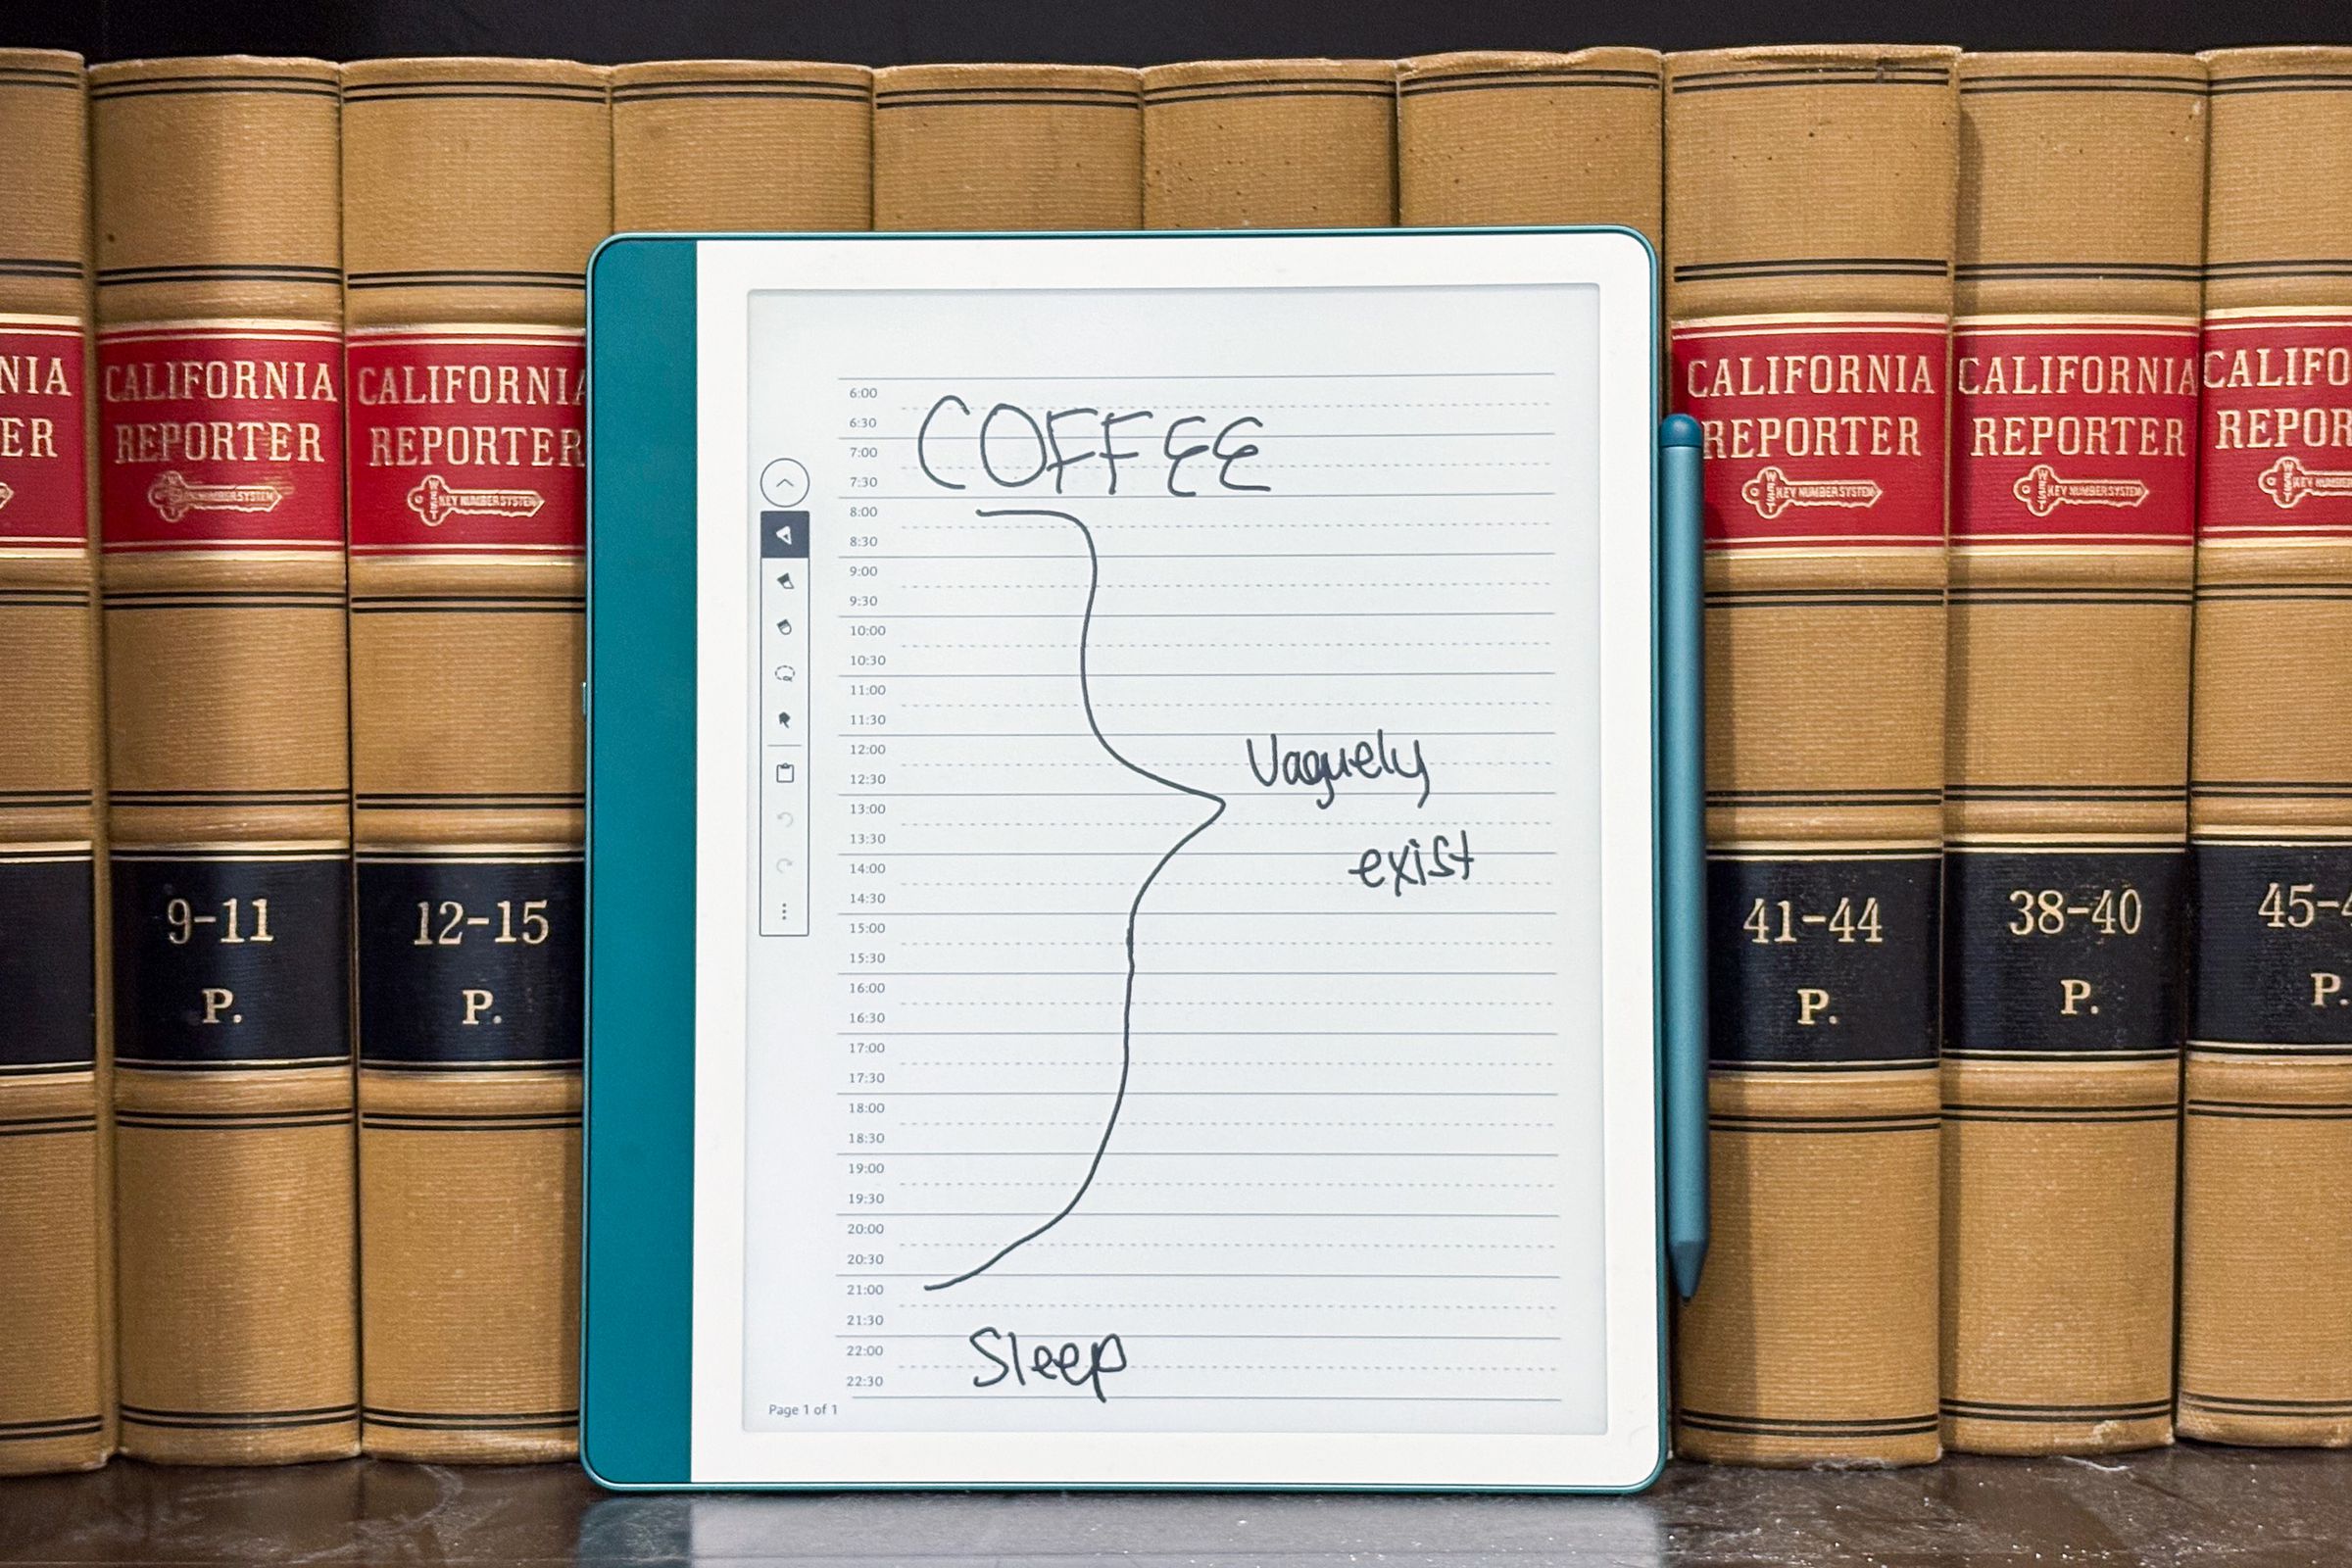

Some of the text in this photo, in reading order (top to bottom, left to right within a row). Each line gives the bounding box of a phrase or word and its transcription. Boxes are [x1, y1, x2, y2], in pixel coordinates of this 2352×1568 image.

[105, 361, 338, 403] CALIFORNIA
[1687, 355, 1936, 398] CALIFORNIA
[1958, 355, 2198, 396] CALIFORNIA
[849, 387, 878, 399] 6:00
[849, 416, 878, 429] 6:30
[115, 421, 325, 465] REPORTER
[1701, 416, 1921, 460] REPORTER
[1970, 416, 2185, 457] REPORTER
[368, 425, 586, 467] REPORTER
[918, 395, 1272, 496] COFFEE
[849, 446, 878, 459] 7:00
[849, 475, 879, 488] 7:30
[849, 506, 879, 518] 8:00
[849, 535, 879, 548] 8:30
[849, 565, 879, 577] 9:00
[849, 595, 878, 608] 9:30
[850, 624, 887, 637] 10:00
[850, 654, 887, 666] 10:30
[850, 684, 887, 697] 11:00
[850, 713, 887, 726] 11:30
[850, 744, 887, 756] 12:00
[850, 773, 887, 786] 12:30
[850, 803, 887, 815] 13:00
[850, 832, 887, 846] 13:30
[849, 862, 887, 875] 14:00
[1348, 829, 1475, 898] exist
[850, 892, 887, 905] 14:30
[2008, 888, 2142, 936] 38-40
[168, 898, 274, 944] 9-11
[413, 900, 550, 946] 12-15
[1742, 897, 1884, 944] 41-44
[848, 922, 887, 934] 15:00
[848, 952, 886, 964] 15:30
[849, 982, 886, 995] 16:00
[2310, 972, 2350, 1007] P.
[2060, 979, 2099, 1015] P.
[202, 988, 243, 1024] P.
[462, 989, 502, 1025] P.
[1797, 988, 1838, 1025] P.
[849, 1011, 886, 1024] 16:30
[849, 1042, 886, 1054] 17:00
[849, 1071, 886, 1085] 17:30
[849, 1102, 886, 1114] 18:00
[848, 1132, 886, 1145] 18:30
[849, 1162, 886, 1175] 19:00
[848, 1193, 885, 1205] 19:30
[847, 1222, 885, 1236] 20:00
[846, 1253, 885, 1266] 20:30
[846, 1283, 885, 1297] 21:00
[846, 1313, 885, 1327] 21:30
[846, 1345, 884, 1357] 22:00
[969, 1326, 1127, 1403] Sleep
[846, 1375, 884, 1388] 22:30
[768, 1403, 838, 1418] Page 1 of 1
